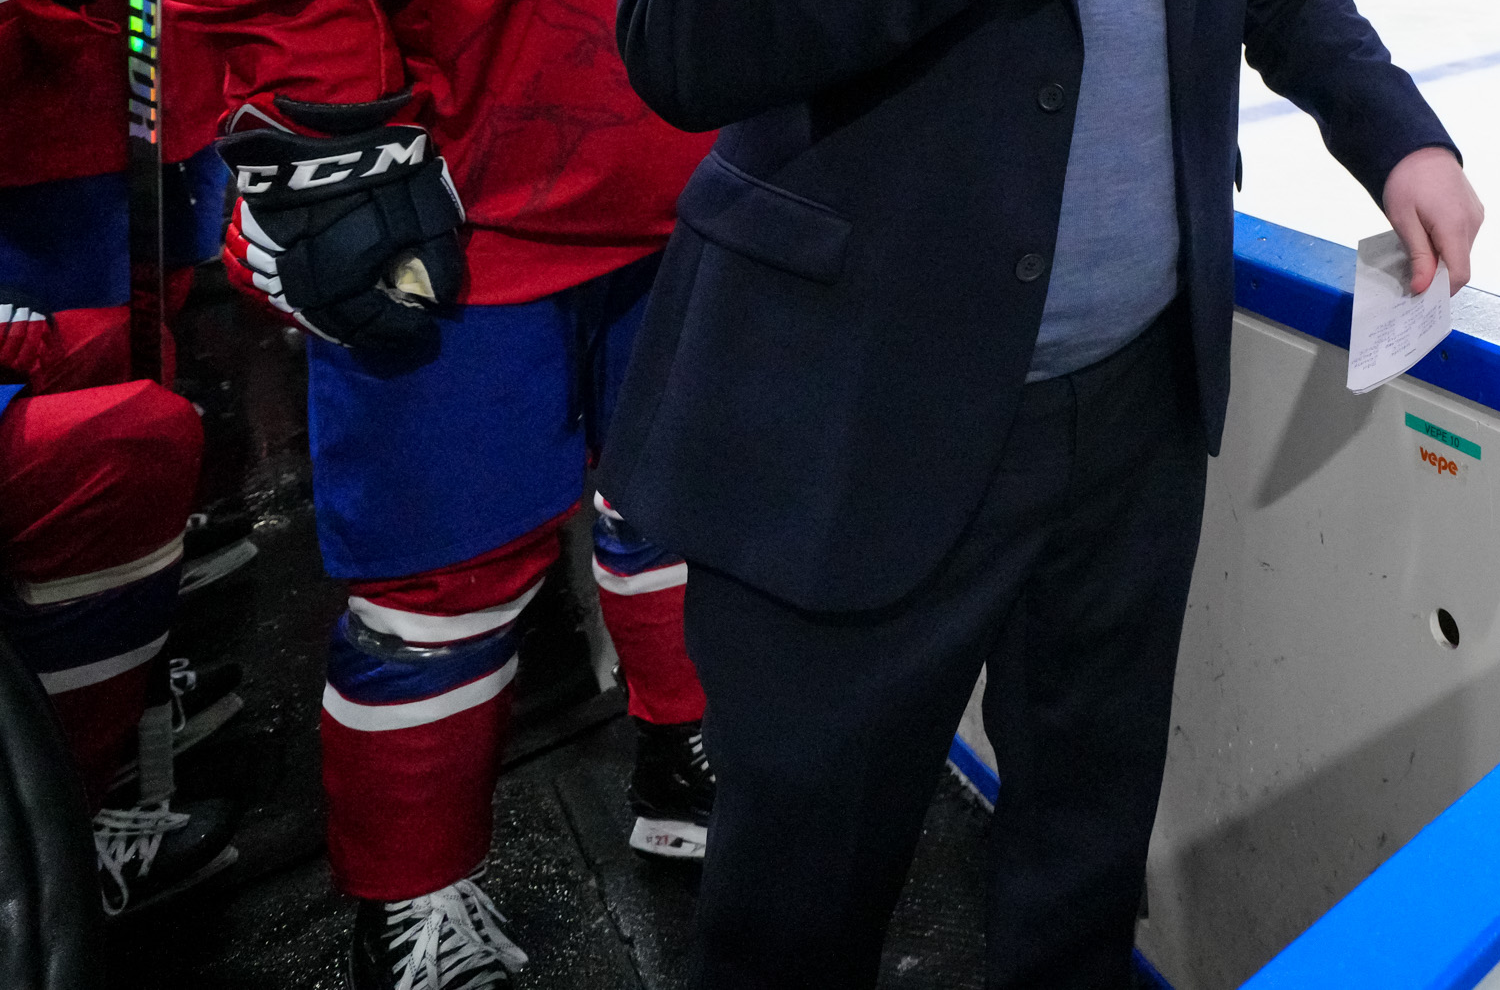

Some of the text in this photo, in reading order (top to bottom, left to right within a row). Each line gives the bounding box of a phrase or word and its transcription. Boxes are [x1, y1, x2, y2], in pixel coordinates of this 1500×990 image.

[236, 133, 427, 193] CCM
[1424, 422, 1460, 448] VEPE 10
[1419, 445, 1459, 476] vepe
